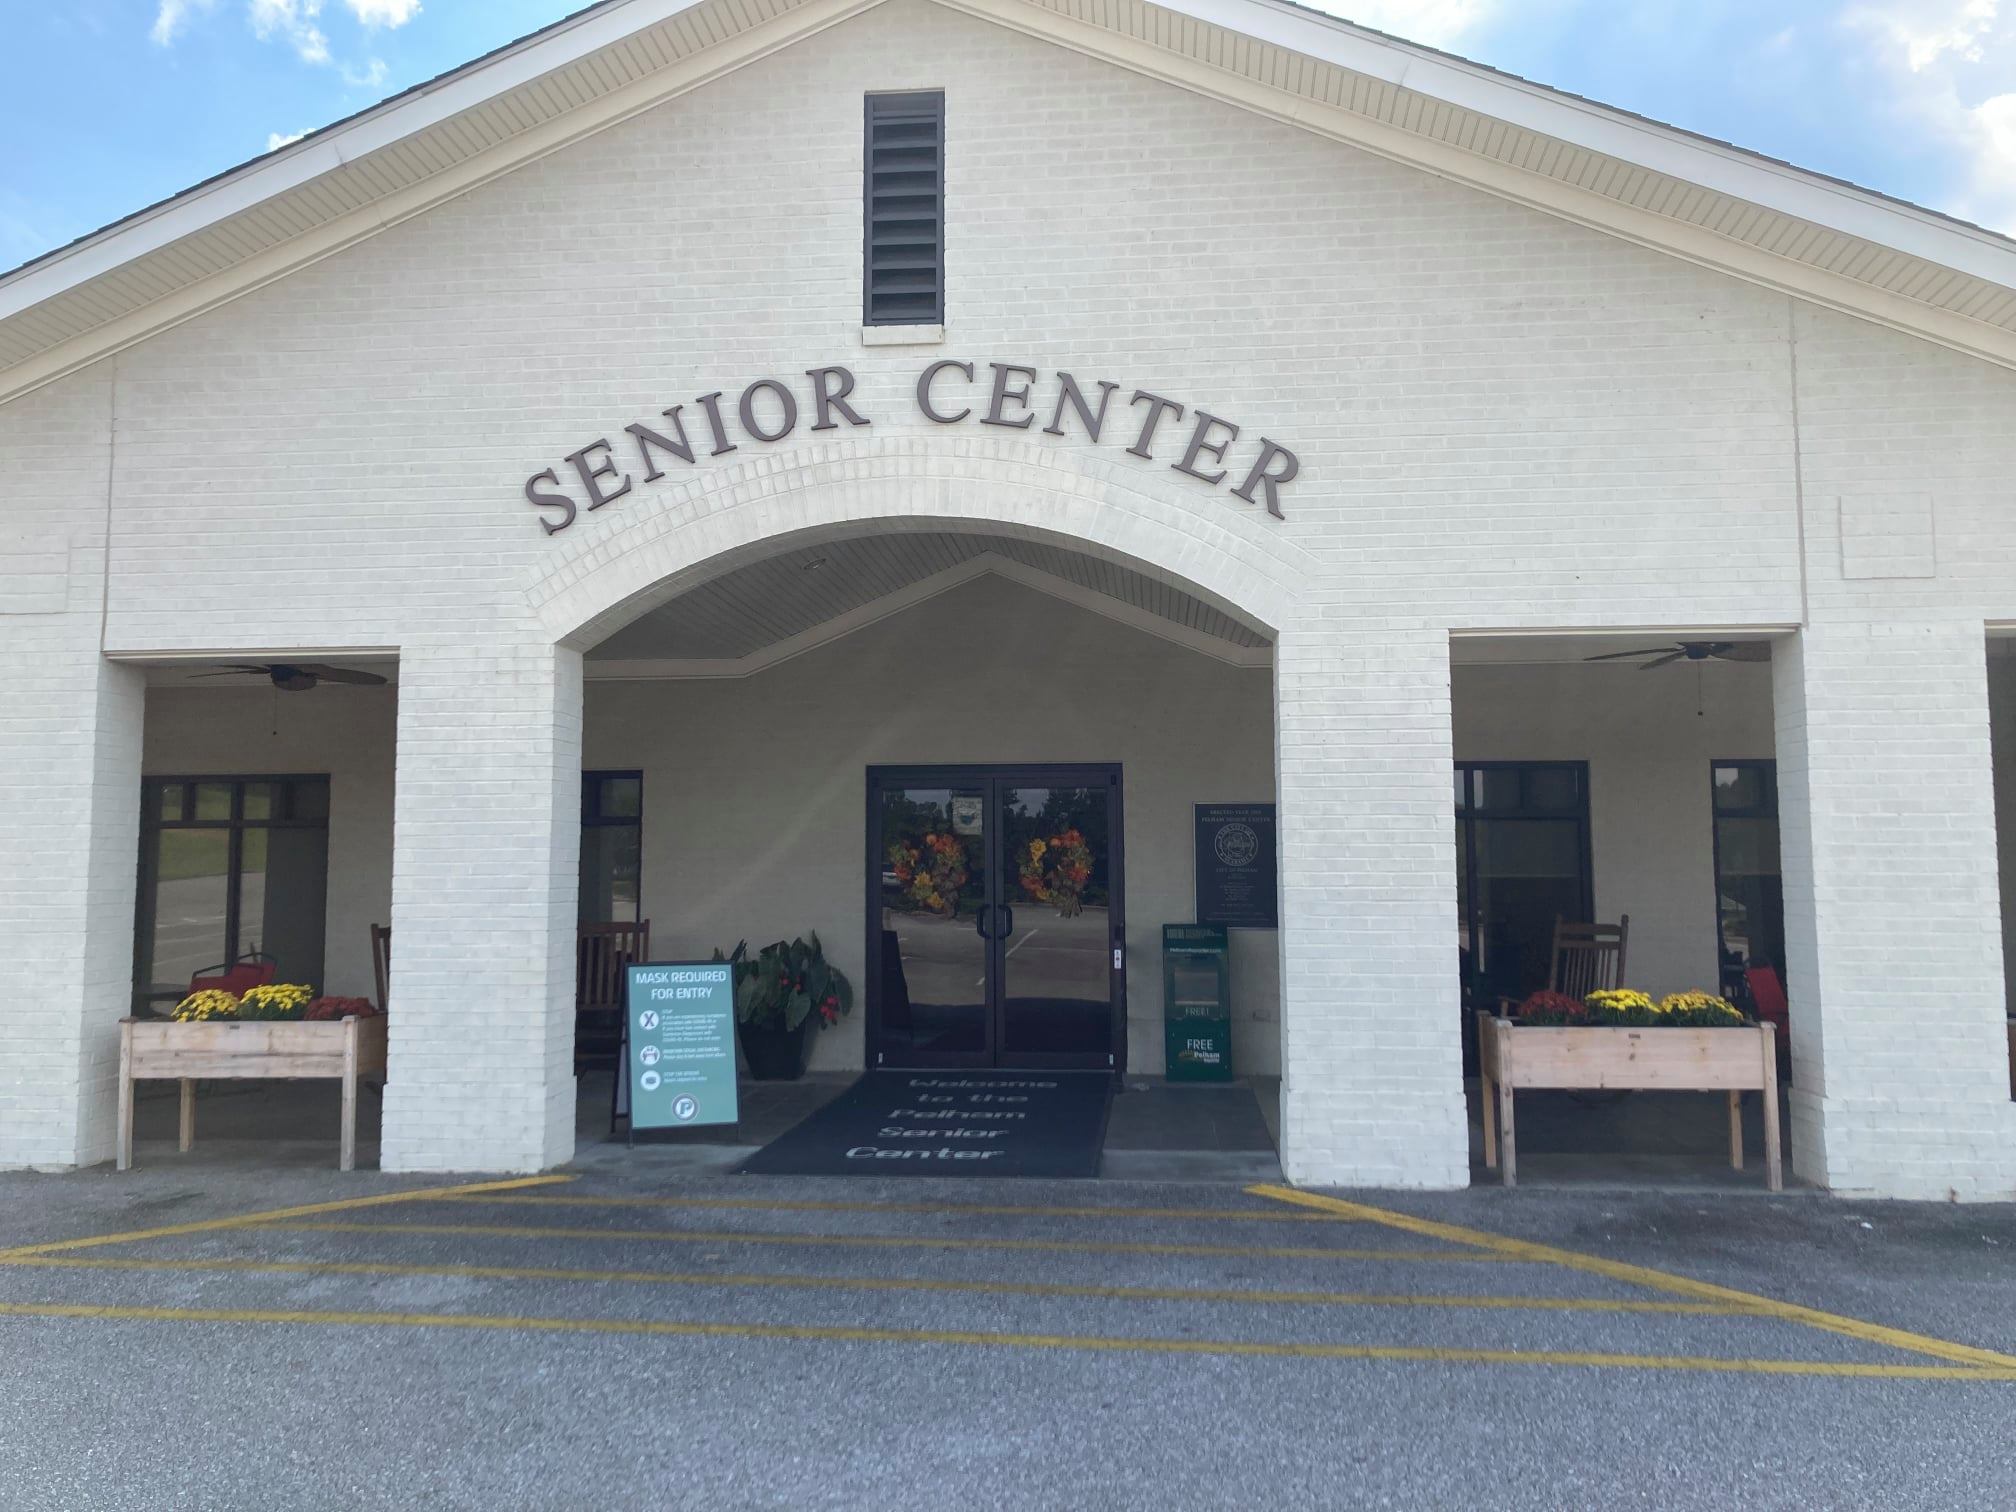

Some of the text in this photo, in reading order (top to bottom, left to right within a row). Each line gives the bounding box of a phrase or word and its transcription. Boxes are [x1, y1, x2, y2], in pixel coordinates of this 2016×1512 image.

[524, 359, 1301, 536] SENIOR CENTER
[635, 970, 726, 984] MASK REQUIRED
[651, 986, 713, 1000] FOR ENTRY
[1187, 1038, 1214, 1050] FREE
[1193, 1050, 1220, 1058] Pelham
[909, 1078, 1058, 1089] Welcome
[917, 1094, 1029, 1103] to the
[887, 1109, 1027, 1119] Pelham
[877, 1126, 1011, 1138] Senior
[845, 1146, 1006, 1160] Center
